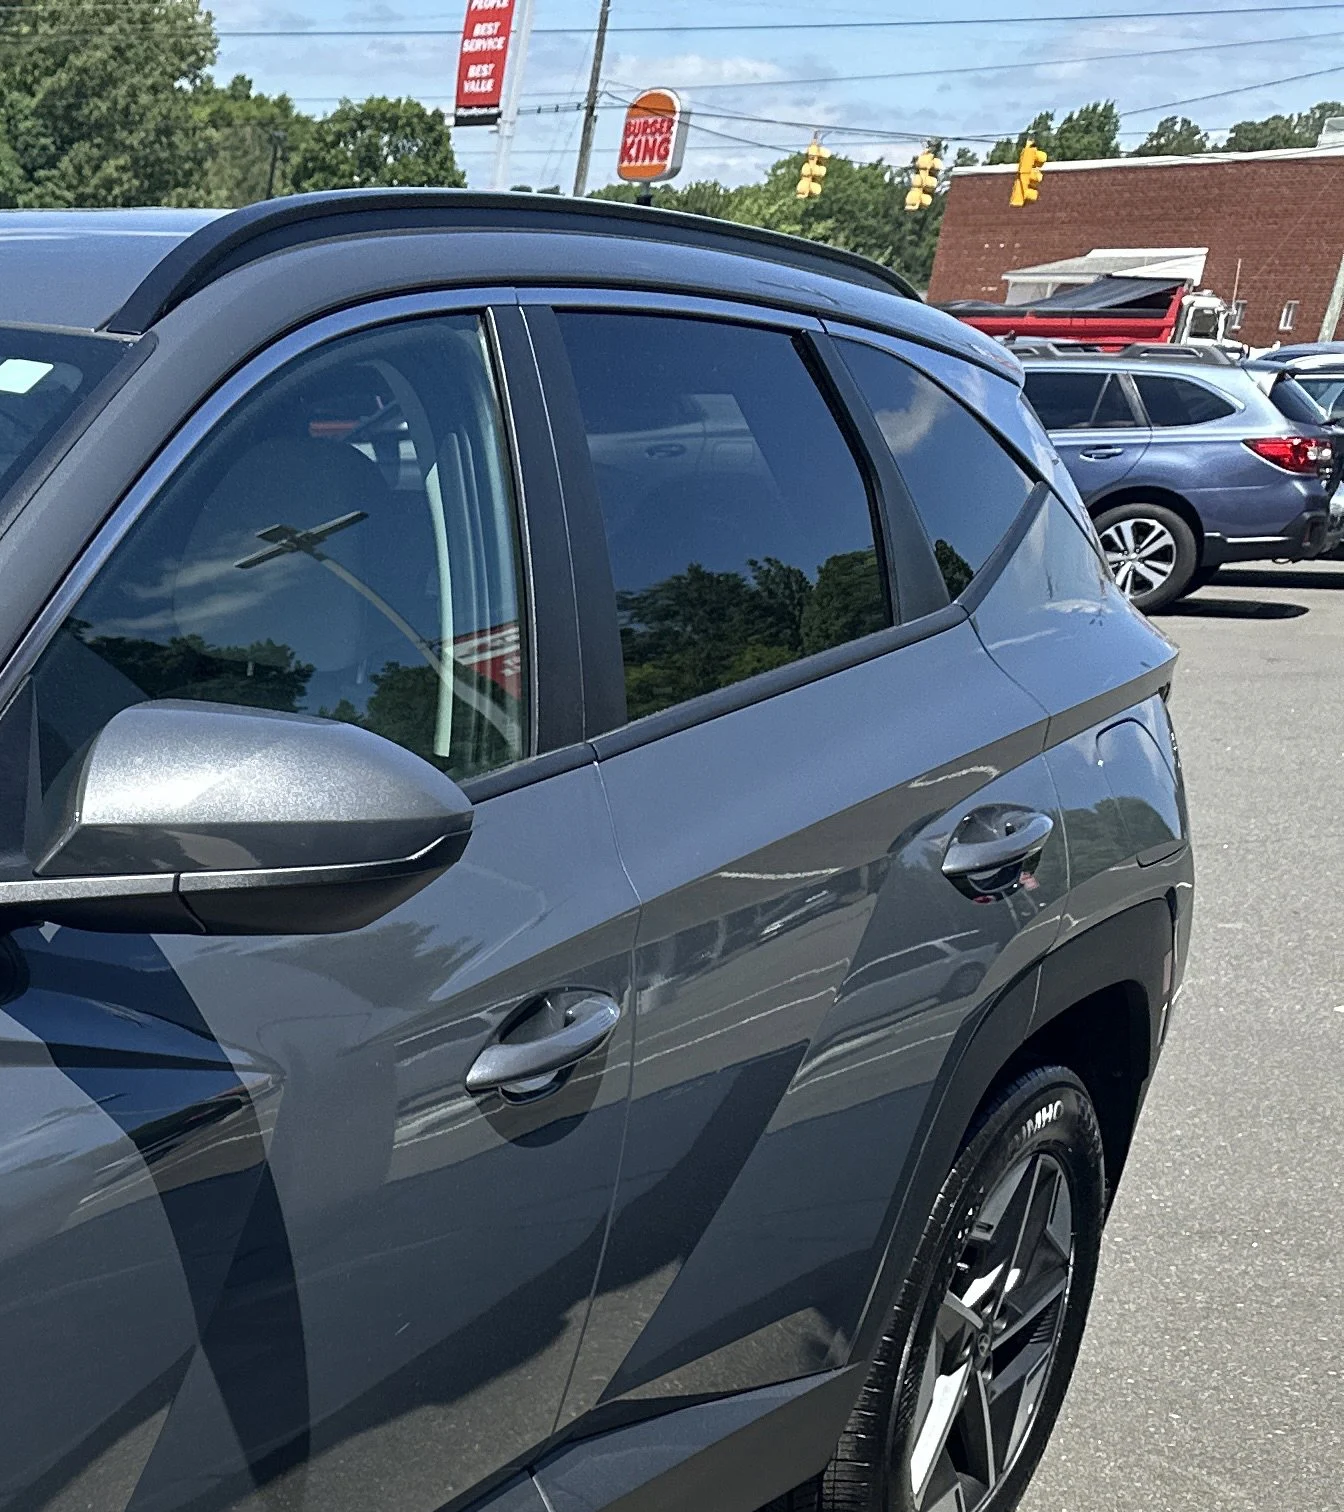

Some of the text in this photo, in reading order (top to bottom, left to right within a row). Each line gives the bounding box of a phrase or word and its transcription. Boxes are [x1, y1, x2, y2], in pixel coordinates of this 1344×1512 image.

[472, 21, 501, 37] BEST
[462, 36, 506, 53] SERVICE
[467, 63, 495, 79] BEST
[463, 78, 495, 94] VALUE
[624, 117, 674, 138] BURGER
[620, 136, 671, 164] KING
